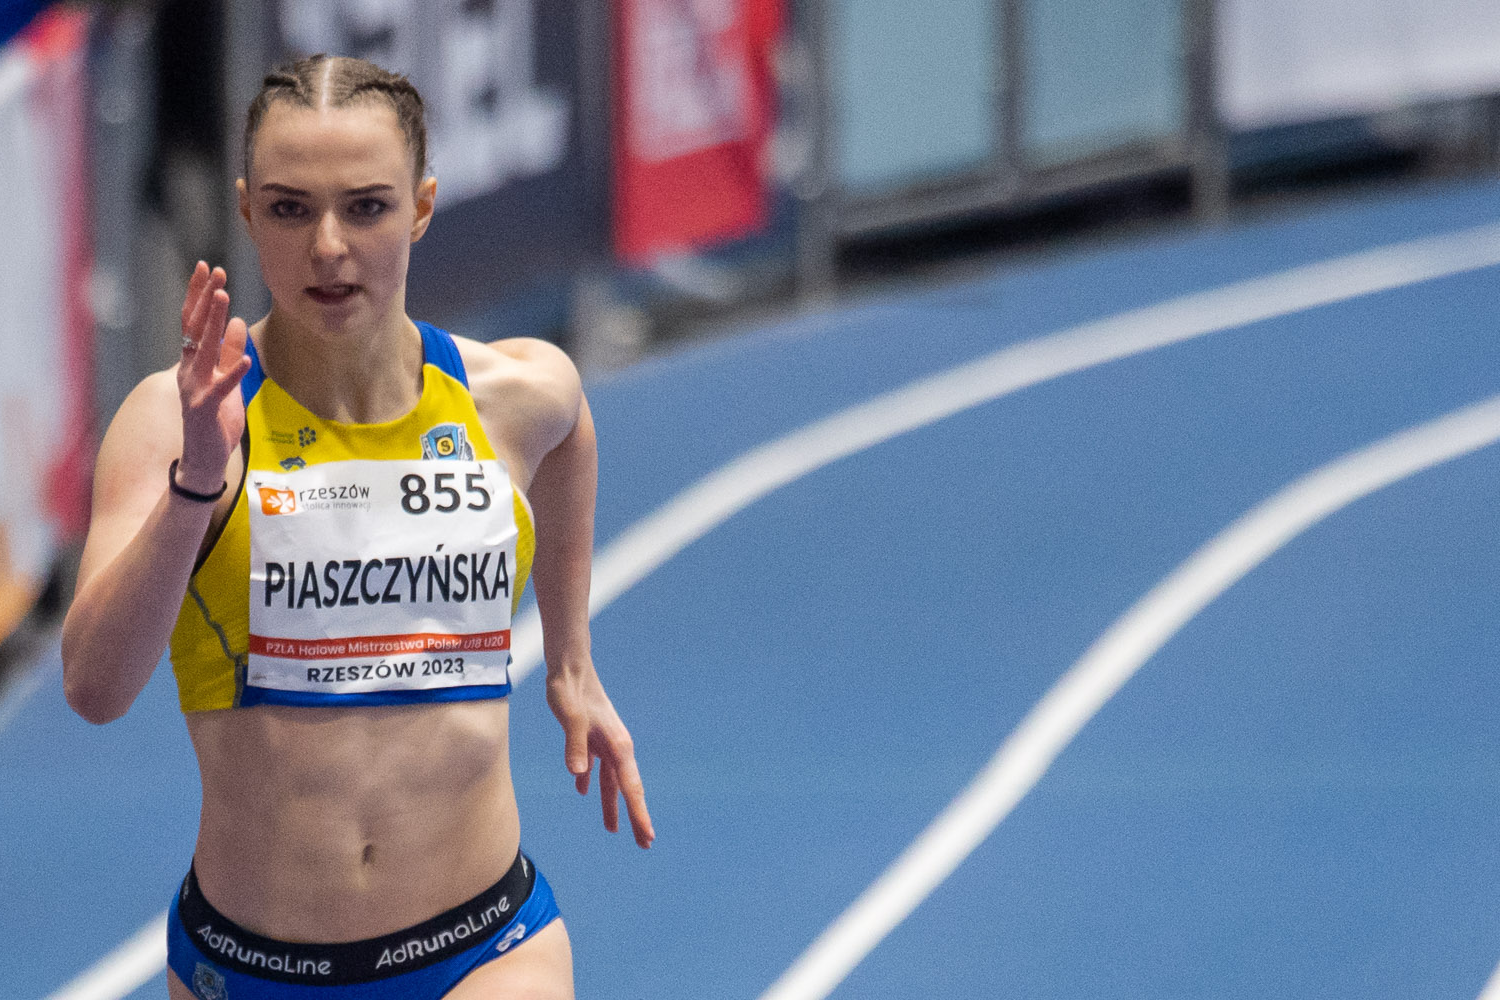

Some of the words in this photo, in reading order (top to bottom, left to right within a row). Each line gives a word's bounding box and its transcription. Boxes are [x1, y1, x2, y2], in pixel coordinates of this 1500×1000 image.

[299, 484, 371, 502] rzeszów
[400, 472, 492, 515] 855
[264, 544, 509, 610] PIASZCZYŃSKA
[266, 642, 295, 655] PZLA
[299, 644, 346, 656] Halowe
[348, 640, 424, 653] Mistrzostwa
[427, 637, 463, 650] Polski
[484, 635, 504, 648] U20
[307, 659, 416, 683] RZESZÓW
[421, 657, 465, 676] 2023
